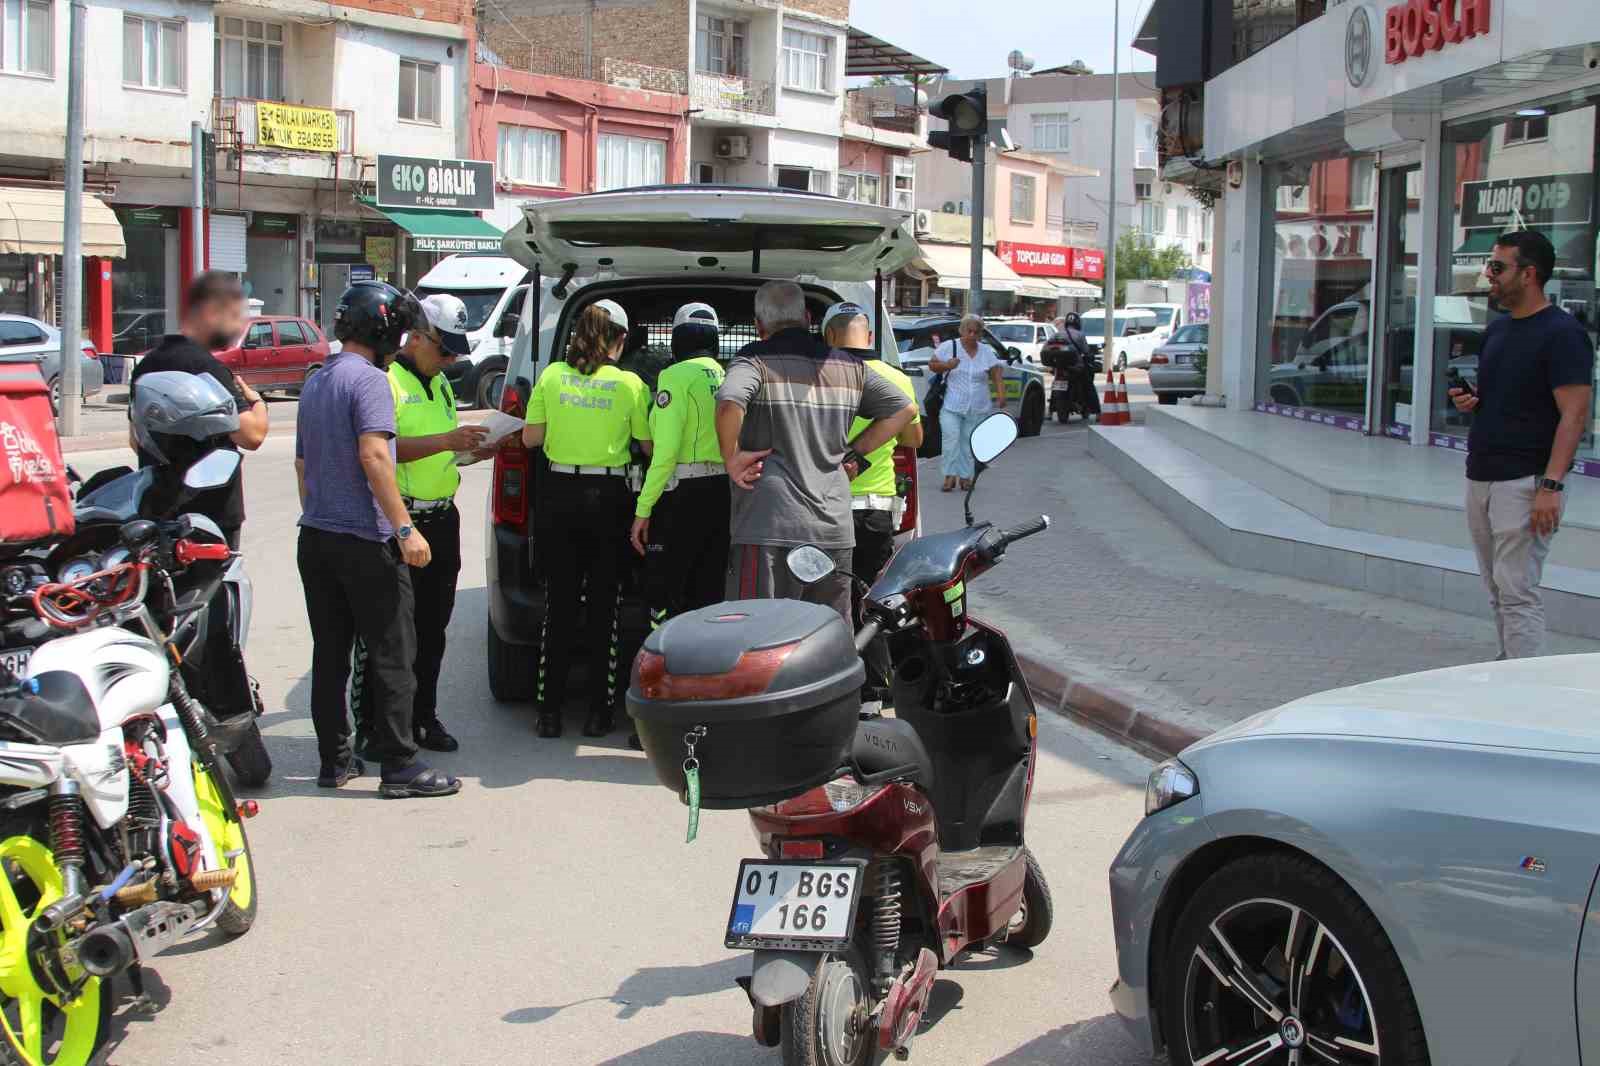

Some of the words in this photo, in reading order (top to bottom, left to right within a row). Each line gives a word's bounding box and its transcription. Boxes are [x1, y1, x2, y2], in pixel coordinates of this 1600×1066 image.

[1384, 0, 1490, 64] BOSCH
[276, 109, 299, 126] EMLAK
[392, 164, 425, 192] EKO
[428, 161, 476, 195] BİRLİK
[864, 732, 898, 753] VOLTA
[745, 870, 779, 897] 01
[797, 871, 851, 899] BGS
[778, 904, 828, 931] 166
